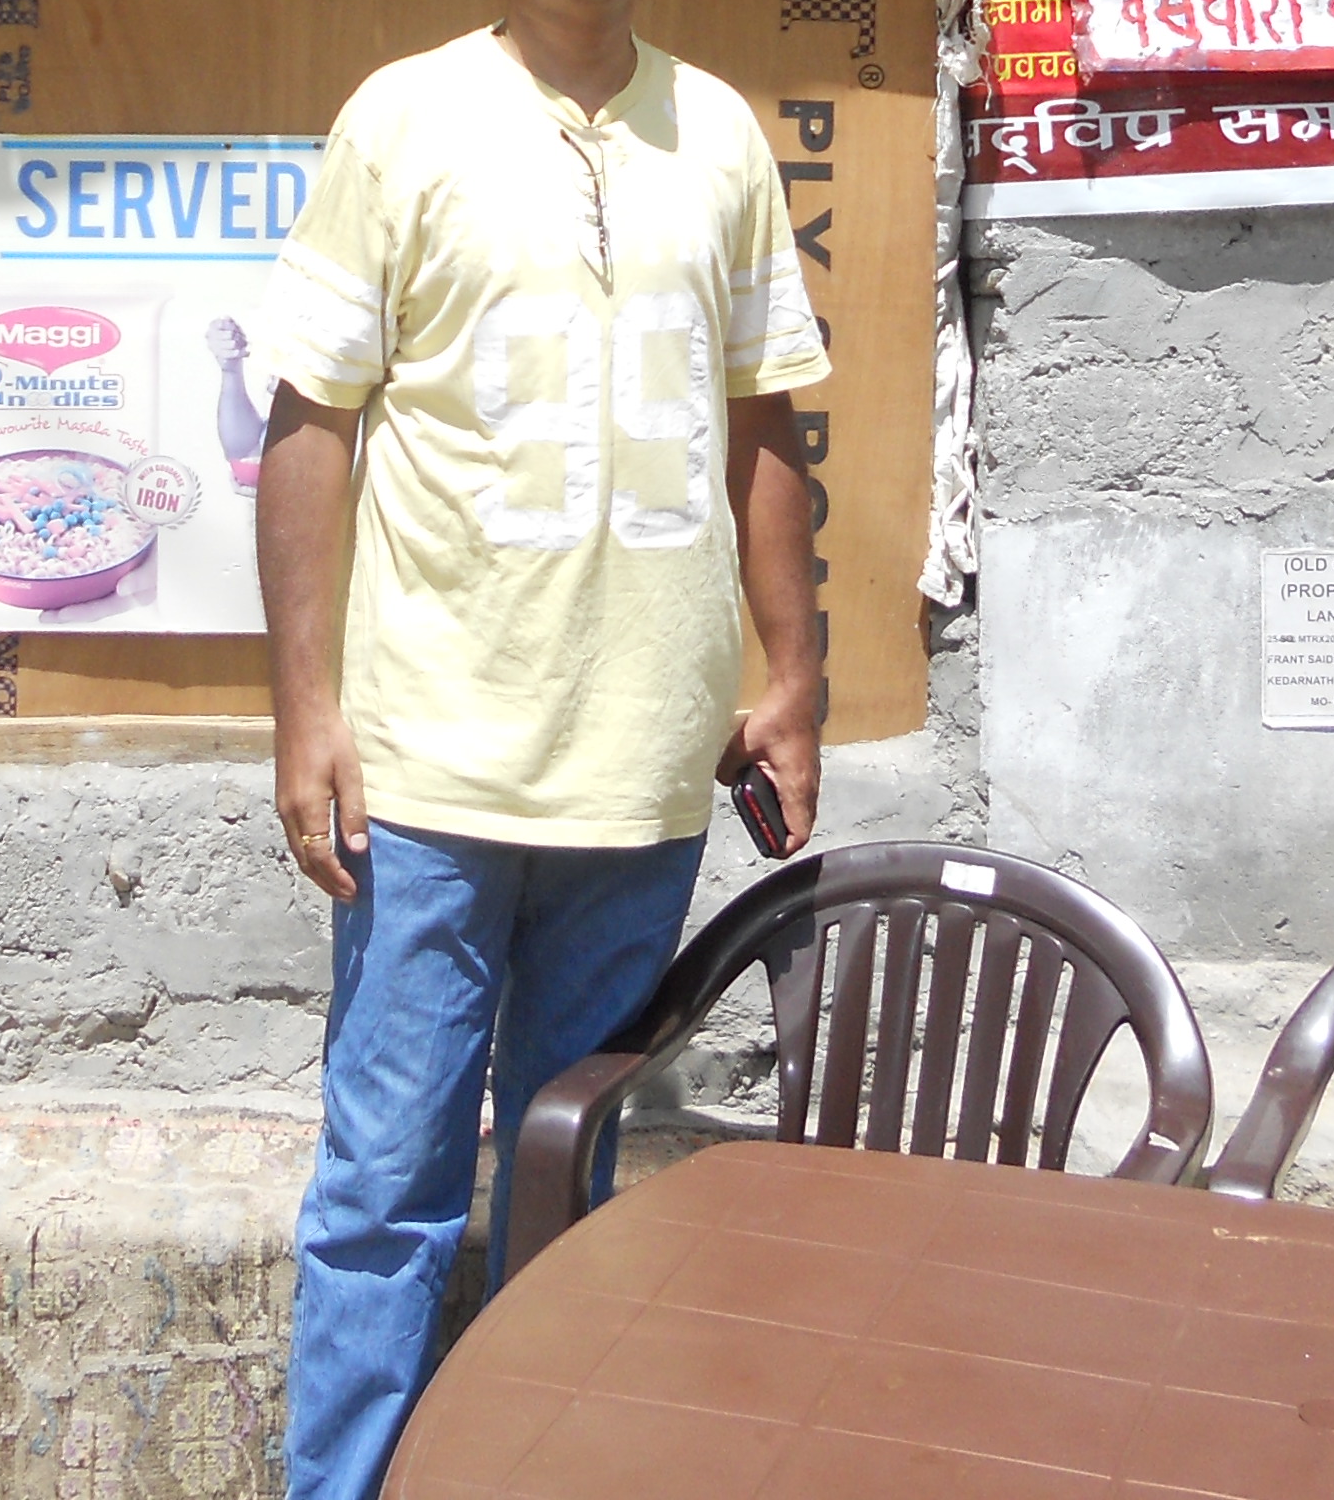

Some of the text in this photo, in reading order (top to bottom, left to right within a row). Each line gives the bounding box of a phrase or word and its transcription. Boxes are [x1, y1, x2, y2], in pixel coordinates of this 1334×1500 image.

[15, 159, 307, 239] SERVED
[57, 417, 111, 438] Masala
[117, 429, 150, 457] Taste
[155, 477, 169, 490] OF
[1283, 557, 1328, 575] (OLD
[1267, 654, 1305, 664] FRANT
[1267, 675, 1334, 686] KEDARNATH
